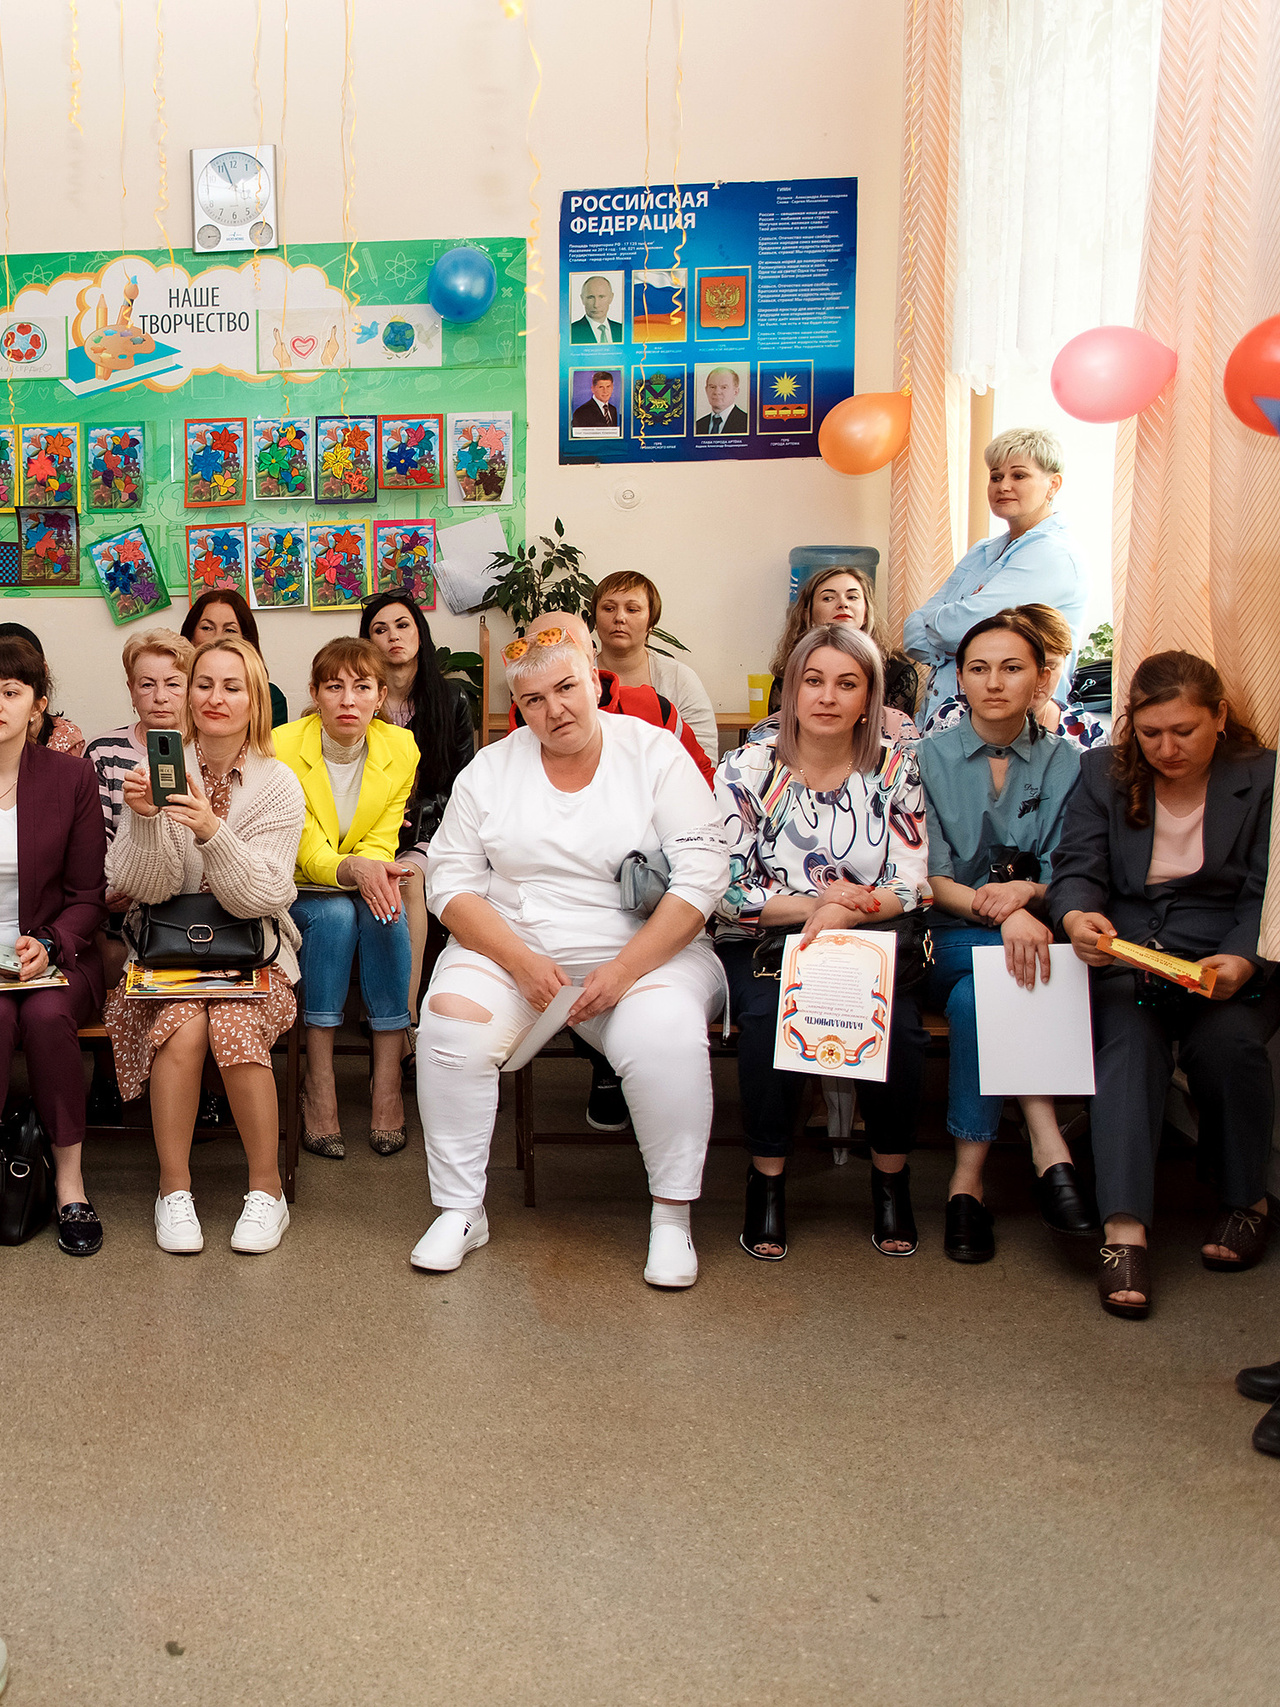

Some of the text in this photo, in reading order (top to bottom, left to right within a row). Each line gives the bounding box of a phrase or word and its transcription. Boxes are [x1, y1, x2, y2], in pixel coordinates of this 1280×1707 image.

[218, 165, 223, 173] 11
[219, 208, 223, 216] 7
[570, 190, 709, 213] РОССИЙСКАЯ
[570, 212, 696, 237] ФЕДЕРАЦИЯ
[169, 287, 220, 308] НАШЕ
[139, 312, 250, 335] ТВОРЧЕСТВО
[804, 1016, 863, 1030] БЛАГОДАРНОСТЬ
